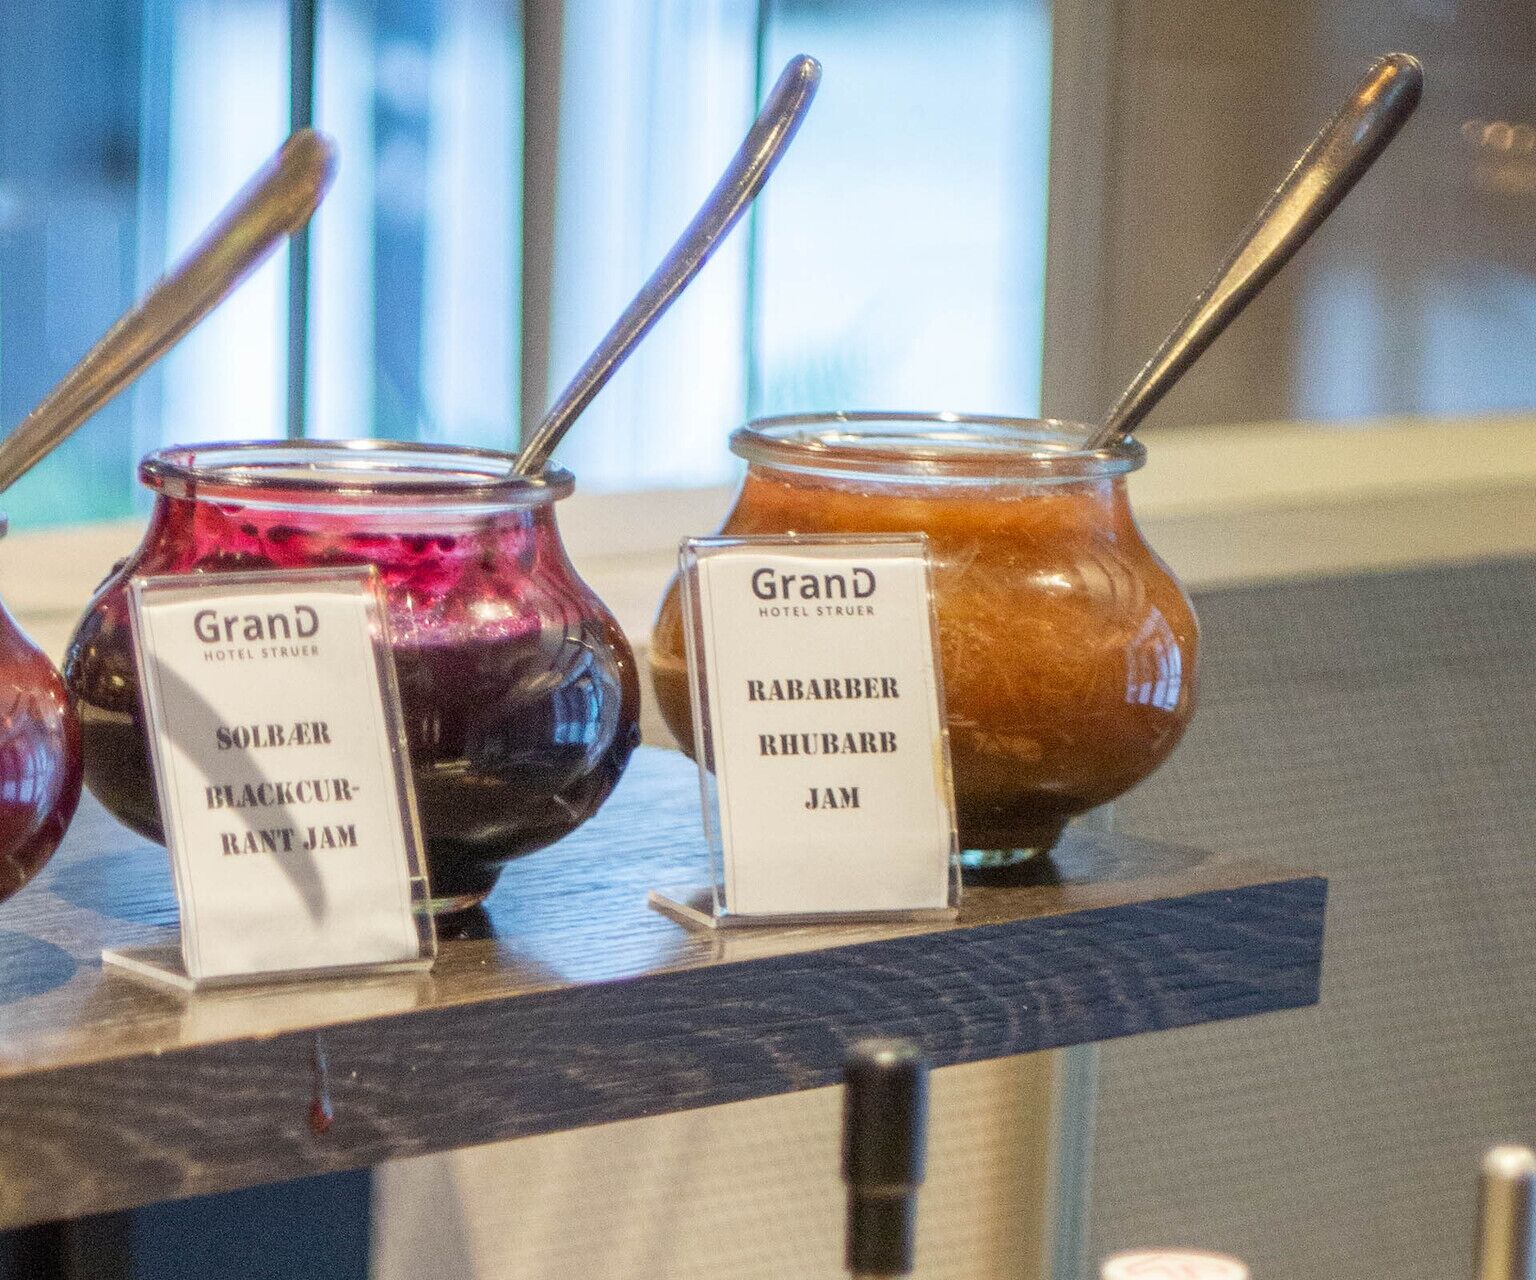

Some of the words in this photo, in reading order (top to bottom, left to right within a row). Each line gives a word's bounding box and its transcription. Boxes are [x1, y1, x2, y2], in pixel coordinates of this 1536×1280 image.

[759, 606, 809, 618] HOTEL
[817, 605, 874, 616] STRUER
[204, 648, 254, 662] HOTEL
[261, 645, 319, 659] STRUER
[747, 676, 900, 702] RABARBER
[215, 721, 332, 751] SOLBÆR
[758, 731, 898, 757] RHUBARB
[204, 778, 361, 811] BLACKCUR-
[804, 786, 861, 810] JAM
[220, 827, 295, 857] RANT
[302, 824, 359, 852] JAM
